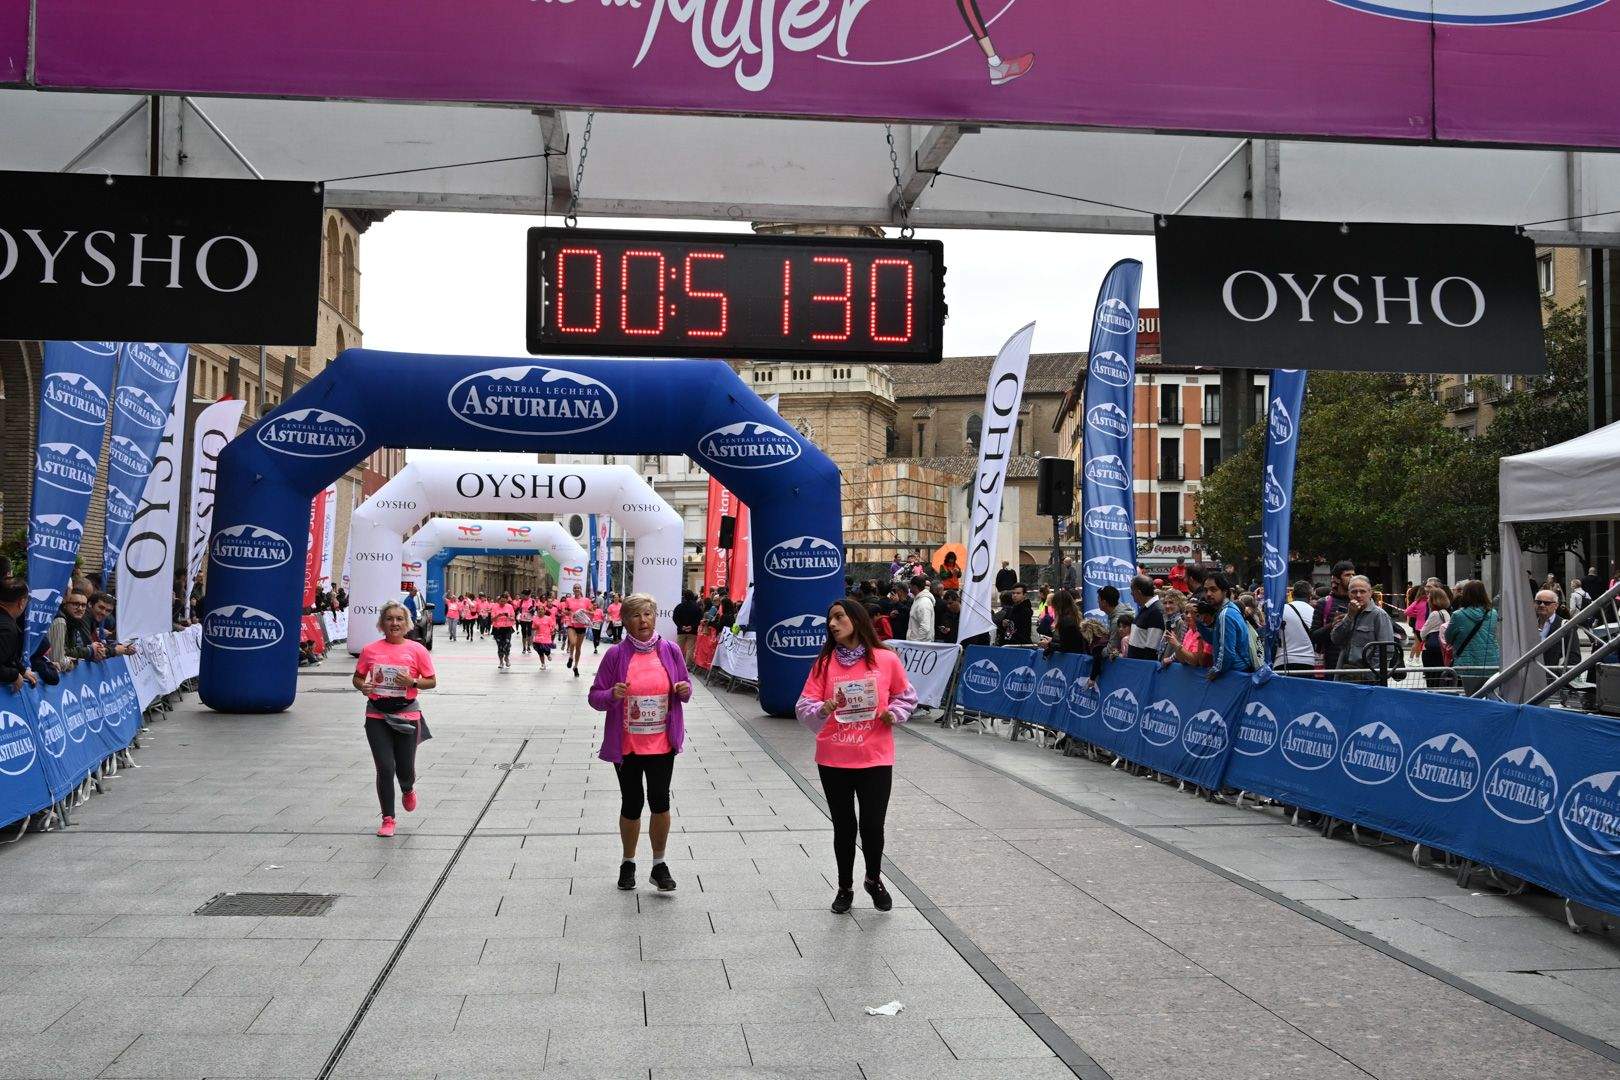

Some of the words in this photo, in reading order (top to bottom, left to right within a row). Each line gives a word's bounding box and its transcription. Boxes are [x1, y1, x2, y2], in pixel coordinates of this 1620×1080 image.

[1222, 269, 1486, 328] OYSHO
[1137, 317, 1160, 333] BU
[131, 343, 177, 380] ASTURIANA
[487, 384, 541, 395] CENTRAL
[546, 387, 600, 396] LECHERA
[44, 380, 107, 421] ASTURIANA
[117, 390, 162, 426] ASTURIANA
[460, 385, 605, 419] ASTURIANA
[263, 424, 357, 447] ASTURIANA
[707, 439, 795, 457] ASTURIANA
[456, 472, 587, 500] OYSHO
[971, 372, 1019, 583] OYSHO
[376, 500, 417, 510] OYSHO
[622, 503, 660, 513] OYSHO
[213, 540, 286, 560] ASTURIANA
[355, 552, 393, 562] OYSHO
[641, 556, 677, 567] OYSHO
[769, 553, 838, 570] ASTURIANA
[206, 619, 277, 640] ASTURIANA
[771, 631, 827, 648] ASTURIA
[847, 696, 863, 704] 016
[831, 733, 864, 744] SUMA
[1239, 726, 1273, 746] TURIANA
[1283, 728, 1332, 759] ASTURIANA
[0, 737, 35, 761] STURIANA
[1344, 740, 1397, 773] ASTURIANA
[1409, 752, 1473, 790] ASTURIANA
